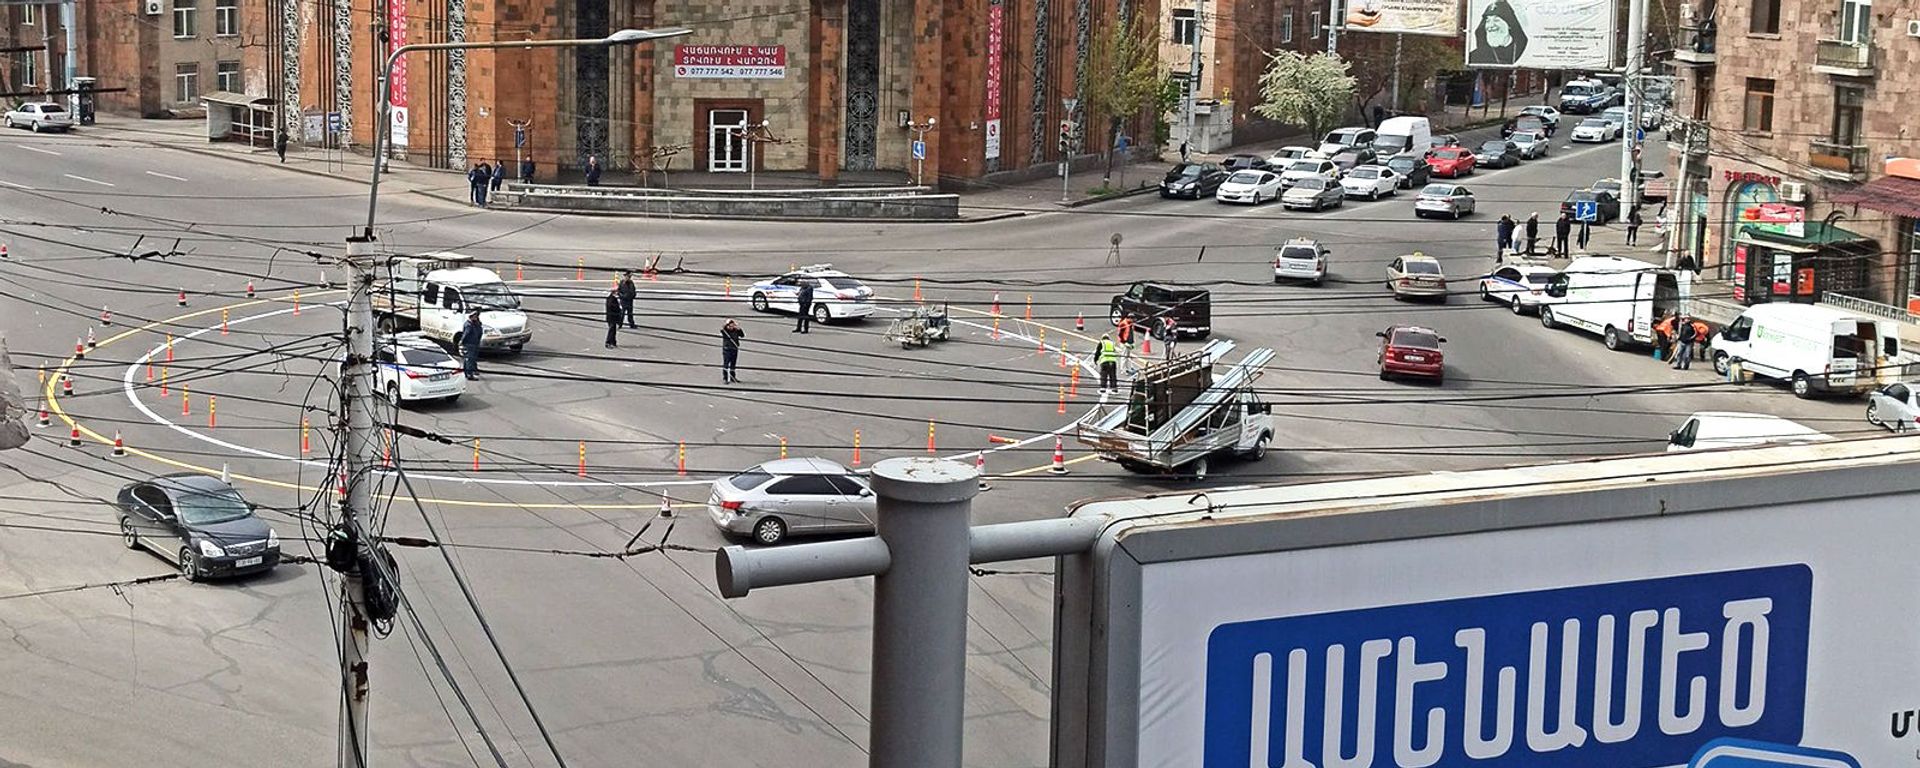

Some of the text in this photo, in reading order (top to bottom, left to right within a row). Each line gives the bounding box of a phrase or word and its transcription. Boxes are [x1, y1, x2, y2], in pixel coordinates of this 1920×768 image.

[683, 47, 778, 55] ՎԱՃԱՌՎՈՒՄ Է ԿԱՄ
[683, 57, 777, 65] ՏՐՎՈՒՄ Է ՎԱՐՁՈՎ
